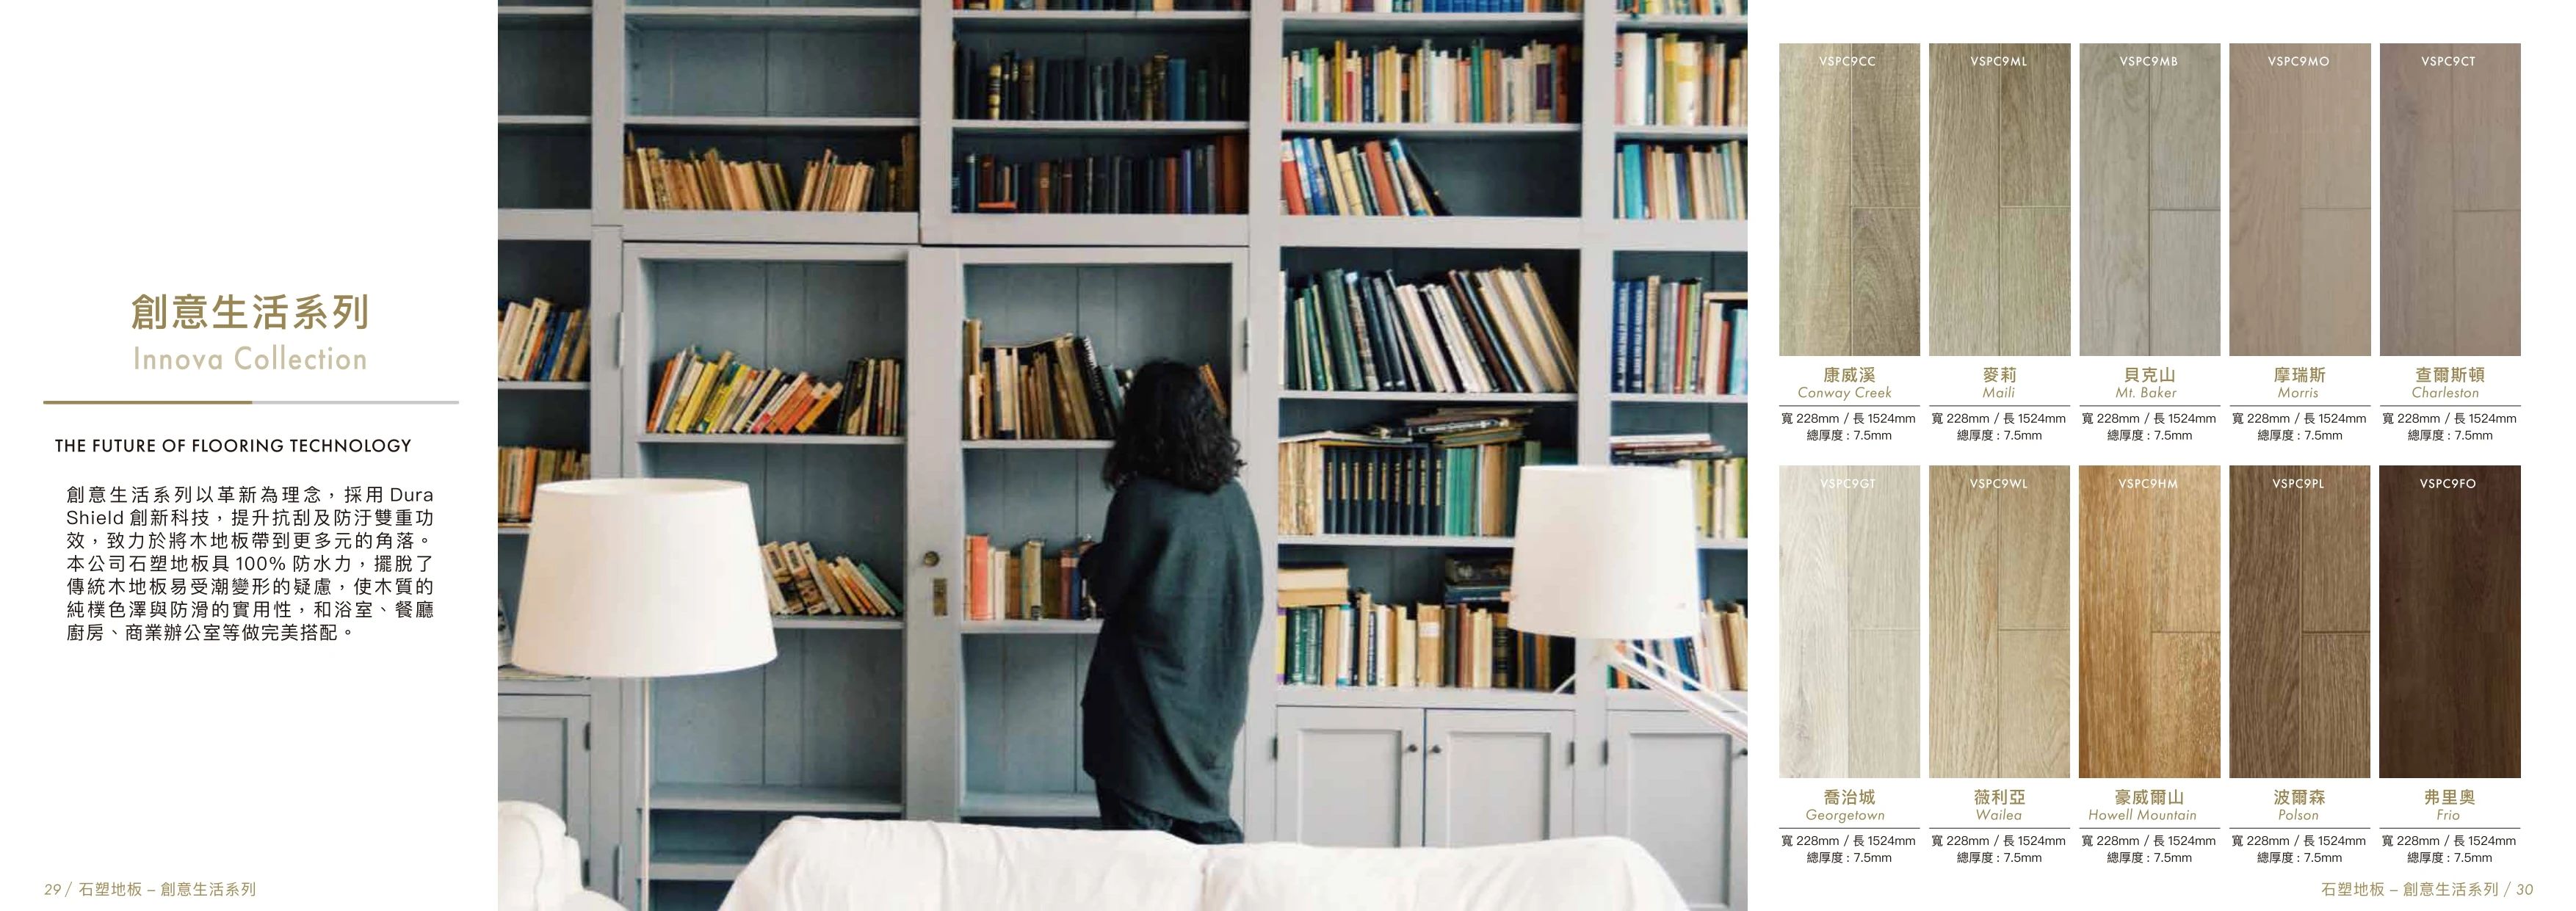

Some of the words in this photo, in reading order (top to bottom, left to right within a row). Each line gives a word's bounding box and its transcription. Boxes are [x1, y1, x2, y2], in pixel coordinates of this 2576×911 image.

[1819, 57, 1875, 67] VSPC9CC
[1970, 57, 2027, 67] VSPC9ML
[2119, 57, 2178, 67] VSPC9MB
[2268, 57, 2329, 67] VSPC9MO
[2421, 57, 2475, 67] VSPC9CT
[131, 293, 368, 330] 創意生活系列
[134, 346, 222, 370] Innova
[234, 344, 366, 370] Collection
[1823, 366, 1875, 383] 康威溪
[1983, 366, 2017, 383] 麥莉
[2124, 366, 2175, 383] 貝克山
[2273, 366, 2326, 383] 摩瑞斯
[2415, 366, 2485, 383] 查爾斯頓
[1798, 386, 1851, 402] Conway
[1855, 385, 1892, 399] Creek
[1982, 385, 2016, 399] Maili
[2115, 386, 2135, 399] Mt.
[2141, 385, 2177, 399] Baker
[2277, 386, 2319, 399] Morris
[2412, 385, 2479, 399] Charleston
[1781, 412, 1793, 425] 寬
[1796, 413, 1839, 424] 228mm
[1853, 412, 1865, 425] 長
[1867, 413, 1916, 424] 1524mm
[1931, 412, 1944, 425] 寬
[1947, 413, 1990, 424] 228mm
[2002, 412, 2015, 425] 長
[2018, 413, 2066, 424] 1524mm
[2082, 412, 2094, 425] 寬
[2096, 413, 2140, 424] 228mm
[2153, 412, 2166, 425] 長
[2168, 413, 2216, 424] 1524mm
[2232, 412, 2244, 425] 寬
[2247, 413, 2290, 424] 228mm
[2303, 412, 2316, 425] 長
[2318, 413, 2367, 424] 1524mm
[2382, 412, 2395, 425] 寬
[2397, 413, 2440, 424] 228mm
[2453, 412, 2466, 425] 長
[2468, 413, 2517, 424] 1524mm
[1806, 429, 1844, 442] 總厚度
[1853, 429, 1892, 440] 7.5mm
[1956, 429, 1994, 442] 總厚度
[2003, 429, 2042, 440] 7.5mm
[2107, 429, 2144, 442] 總厚度
[2154, 429, 2193, 440] 7.5mm
[2257, 429, 2294, 442] 總厚度
[2304, 429, 2343, 440] 7.5mm
[2407, 429, 2445, 442] 總厚度
[2454, 429, 2493, 440] 7.5mm
[54, 438, 86, 453] THE
[93, 438, 156, 453] FUTURE
[162, 438, 186, 453] OF
[192, 438, 284, 453] FLOORING
[289, 438, 412, 453] TECHNOLOGY
[1820, 479, 1875, 489] VSPC9GT
[1970, 479, 2027, 489] VSPC9WL
[2119, 479, 2178, 489] VSPC9HM
[2273, 479, 2323, 489] VSPC9PL
[2420, 479, 2476, 489] VSPC9FO
[66, 485, 383, 504] 創意生活系列以革新為理念，採用
[390, 487, 433, 502] Dura
[66, 509, 123, 526] Shield
[129, 508, 433, 527] 創新科技，提升抗刮及防汙雙重功
[66, 531, 428, 550] 效，致力於將木地板帶到更多元的角落。
[66, 554, 230, 573] 本公司石塑地板具
[236, 556, 286, 571] 100%
[293, 554, 433, 573] 防水力，擺脫了
[66, 577, 433, 596] 傳統木地板易受潮變形的疑慮，使木質的
[67, 600, 434, 619] 純樸色澤與防滑的實用性，和浴室、餐廳
[66, 623, 351, 642] 廚房、商業辦公室等做完美搭配。
[1823, 788, 1876, 806] 喬治城
[1974, 788, 2026, 806] 薇利亞
[2115, 788, 2184, 806] 豪威爾山
[2273, 788, 2326, 806] 波爾森
[2424, 788, 2475, 806] 弗里奧
[1806, 808, 1885, 824] Georgetown
[1975, 807, 2022, 821] Wailea
[2088, 807, 2133, 821] Howell
[2137, 808, 2197, 821] Mountain
[2278, 807, 2319, 821] Polson
[2436, 808, 2461, 821] Frio
[1781, 834, 1793, 847] 寬
[1796, 835, 1839, 846] 228mm
[1853, 835, 1865, 847] 長
[1867, 835, 1916, 846] 1524mm
[1931, 834, 1944, 847] 寬
[1946, 835, 1989, 846] 228mm
[2002, 835, 2015, 847] 長
[2017, 835, 2066, 846] 1524mm
[2081, 834, 2094, 847] 寬
[2096, 835, 2140, 846] 228mm
[2153, 835, 2166, 847] 長
[2168, 835, 2216, 846] 1524mm
[2232, 834, 2244, 847] 寬
[2246, 835, 2290, 846] 228mm
[2303, 835, 2315, 847] 長
[2318, 835, 2366, 846] 1524mm
[2381, 834, 2394, 847] 寬
[2397, 835, 2440, 846] 228mm
[2453, 835, 2465, 847] 長
[2468, 835, 2517, 846] 1524mm
[1806, 851, 1843, 864] 總厚度
[1853, 852, 1892, 863] 7.5mm
[1956, 851, 1994, 864] 總厚度
[2003, 852, 2042, 863] 7.5mm
[2107, 851, 2143, 864] 總厚度
[2153, 852, 2192, 863] 7.5mm
[2257, 851, 2294, 864] 總厚度
[2304, 852, 2342, 863] 7.5mm
[2407, 851, 2444, 864] 總厚度
[2453, 852, 2492, 863] 7.5mm
[43, 883, 62, 896] 29
[79, 881, 142, 897] 石塑地板
[160, 881, 256, 897] 創意生活系列
[2321, 881, 2385, 897] 石塑地板
[2403, 881, 2498, 897] 創意生活系列
[2516, 883, 2533, 896] 30
